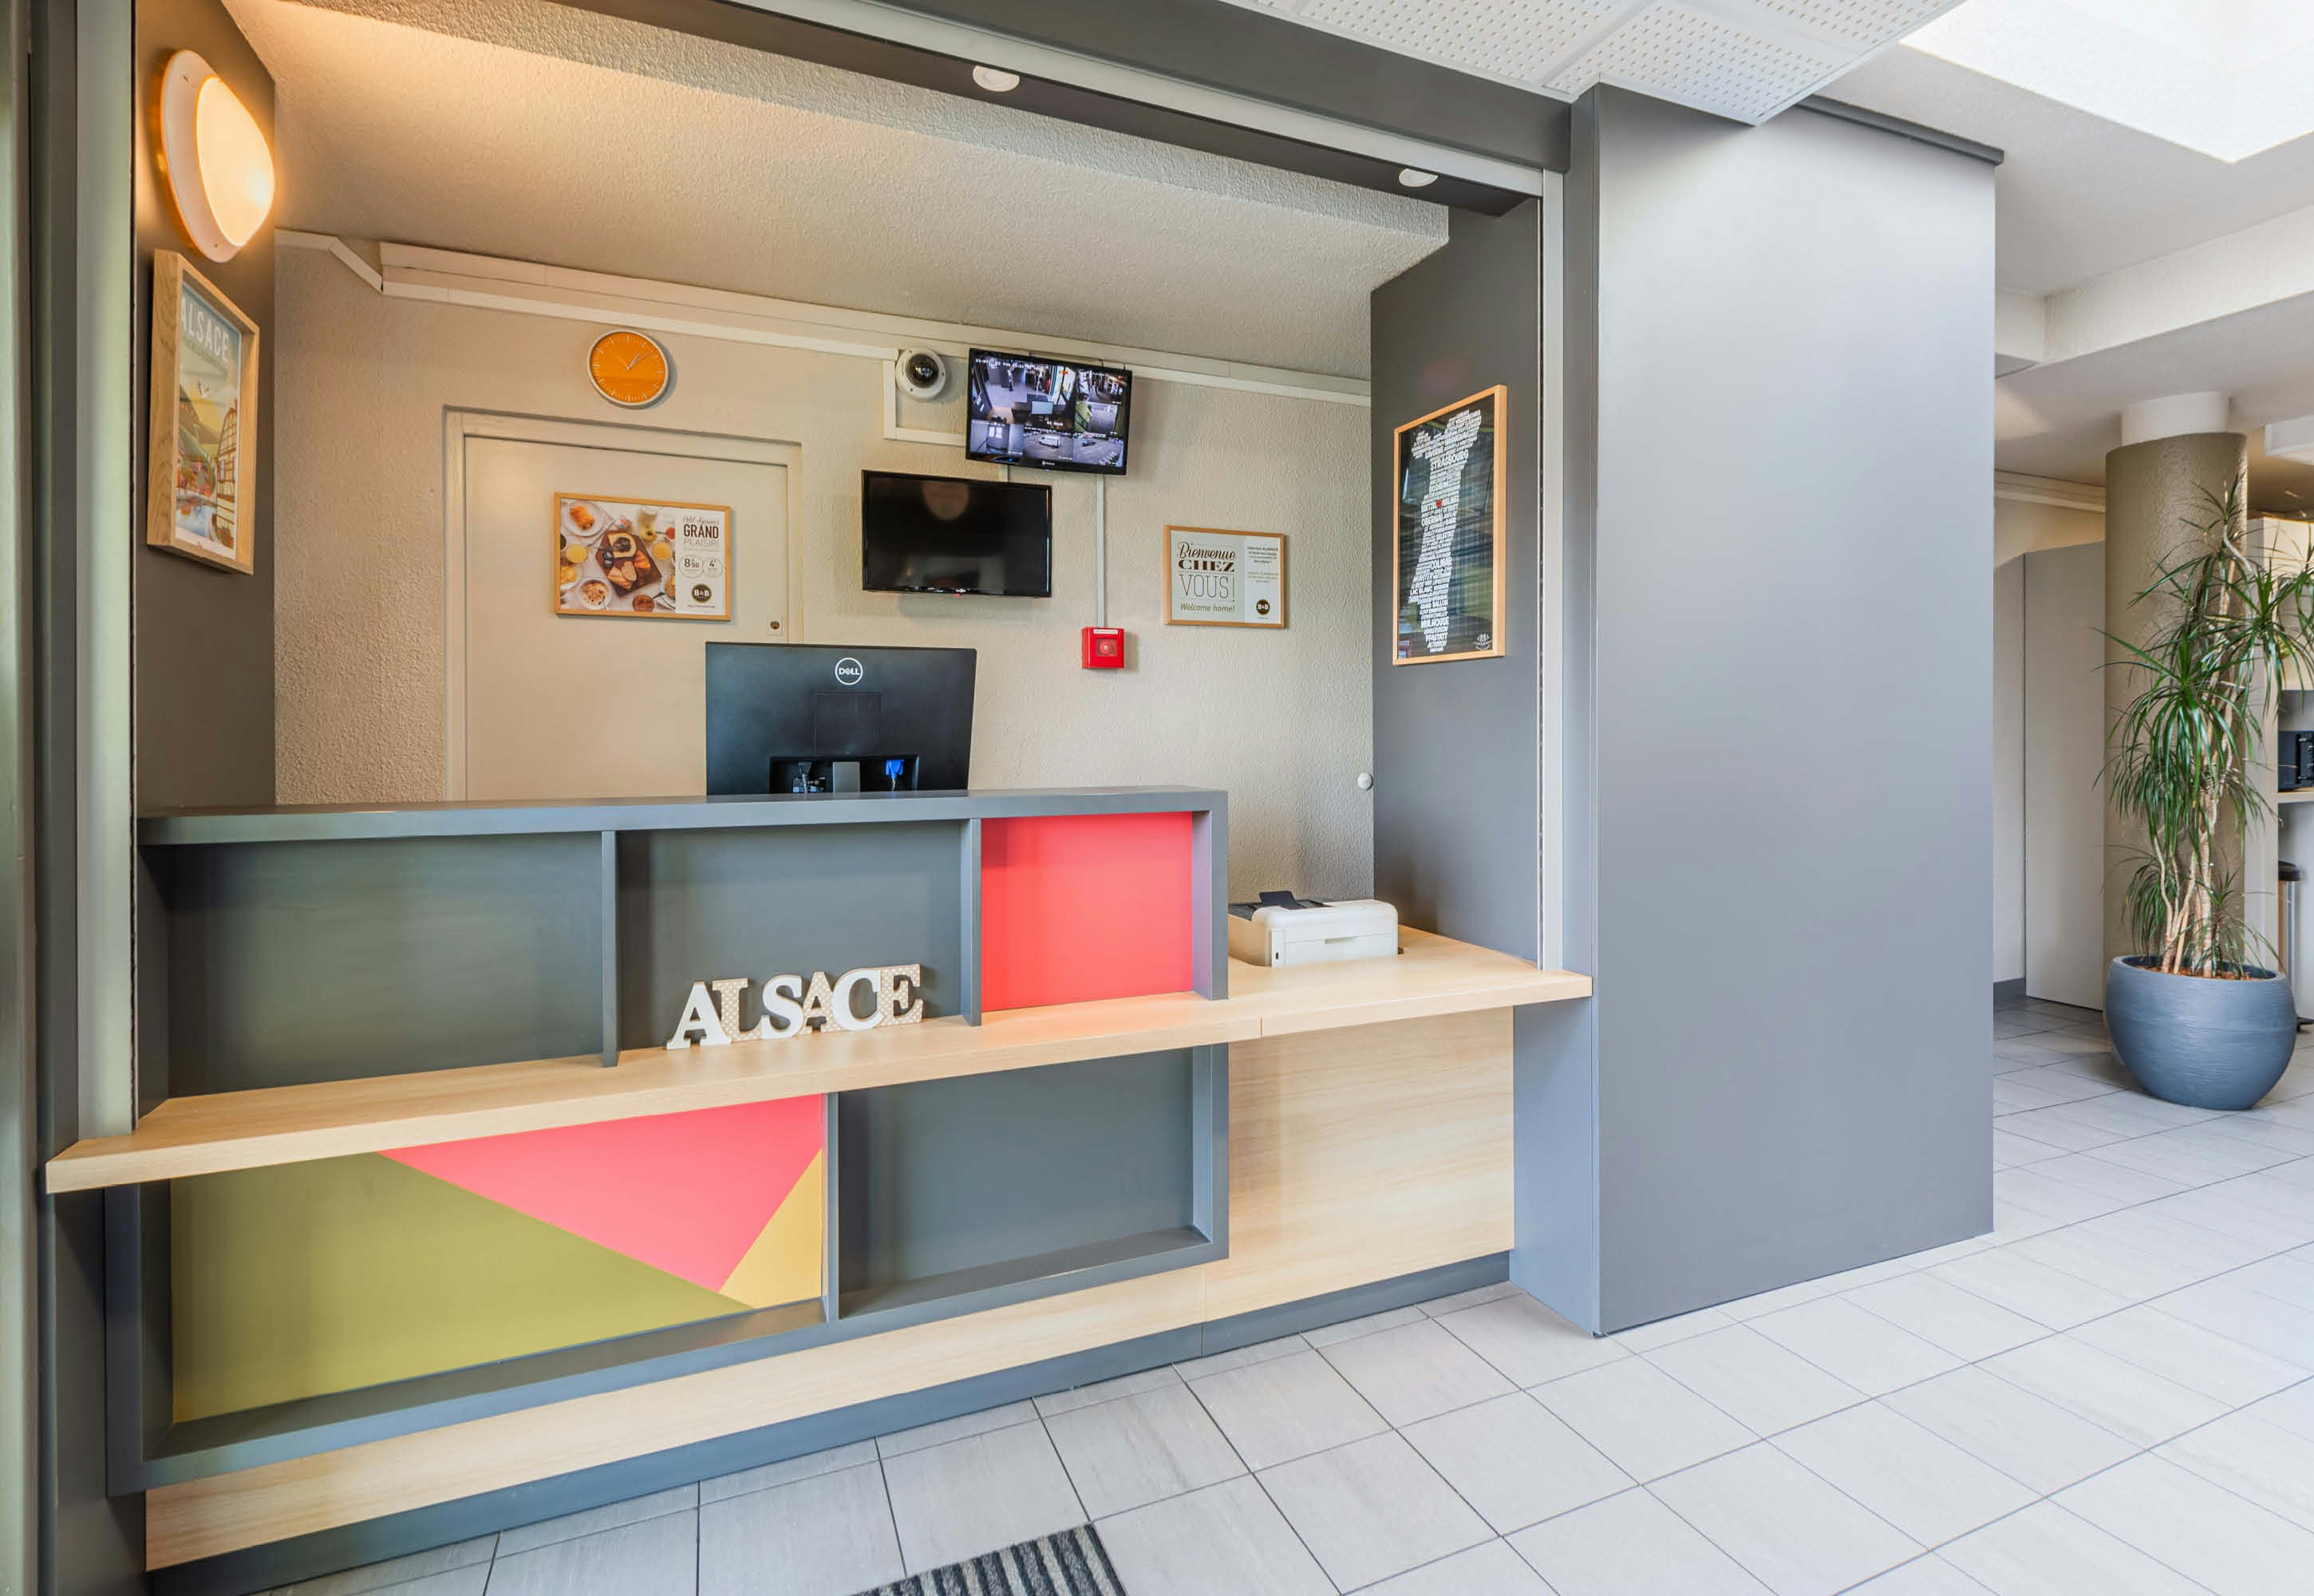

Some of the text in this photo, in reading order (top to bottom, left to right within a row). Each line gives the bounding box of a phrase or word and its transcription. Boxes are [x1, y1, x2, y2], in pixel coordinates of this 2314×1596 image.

[1430, 448, 1469, 471] STRASBOURG
[683, 523, 719, 539] GRAND
[1178, 542, 1236, 559] Bienvenue
[1178, 559, 1235, 572] CHEZ
[1430, 557, 1452, 570] COLMAR
[1180, 602, 1235, 613] Welcome home!
[1420, 616, 1449, 629] MULHOUSE
[666, 963, 923, 1050] ALSACE
